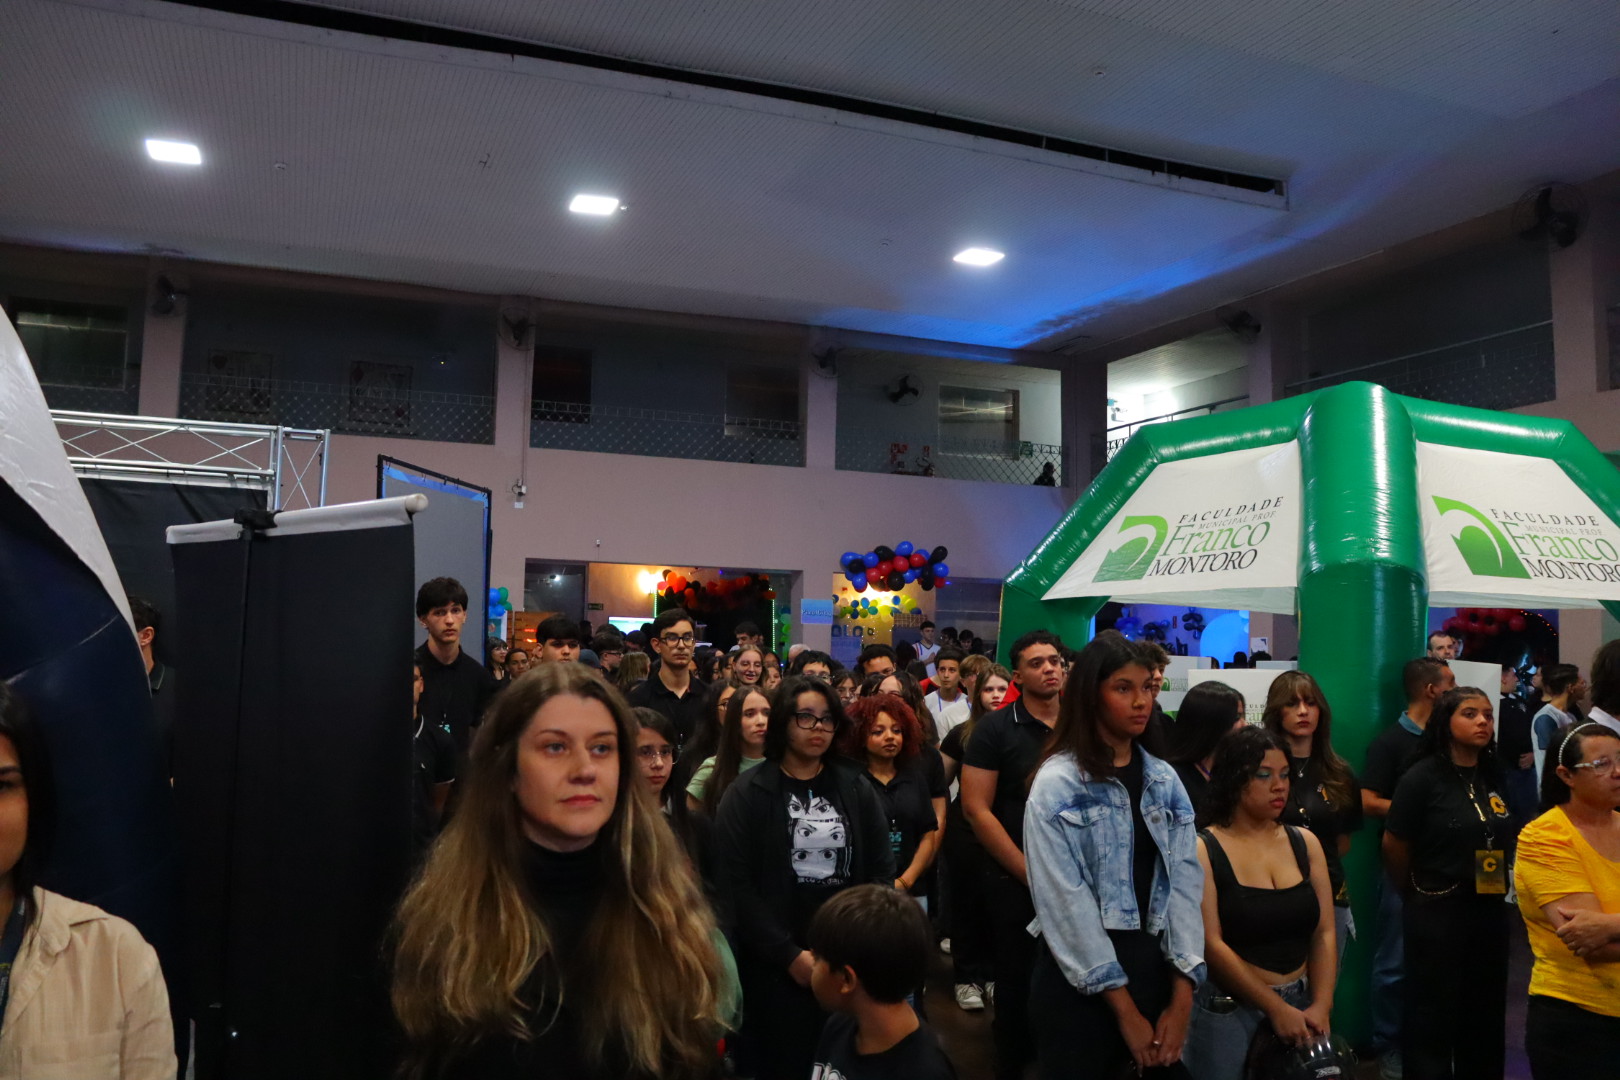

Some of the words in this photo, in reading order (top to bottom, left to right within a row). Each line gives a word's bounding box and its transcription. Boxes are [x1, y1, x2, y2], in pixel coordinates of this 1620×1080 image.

[1179, 496, 1284, 524] FACULDADE
[1199, 515, 1248, 530] MUNICIPAL
[1490, 508, 1600, 526] FACULDADE
[1159, 521, 1271, 556] Franco
[1498, 520, 1618, 562] Franco
[1524, 524, 1577, 536] MUNICIPAL
[1147, 548, 1258, 577] MONTORO
